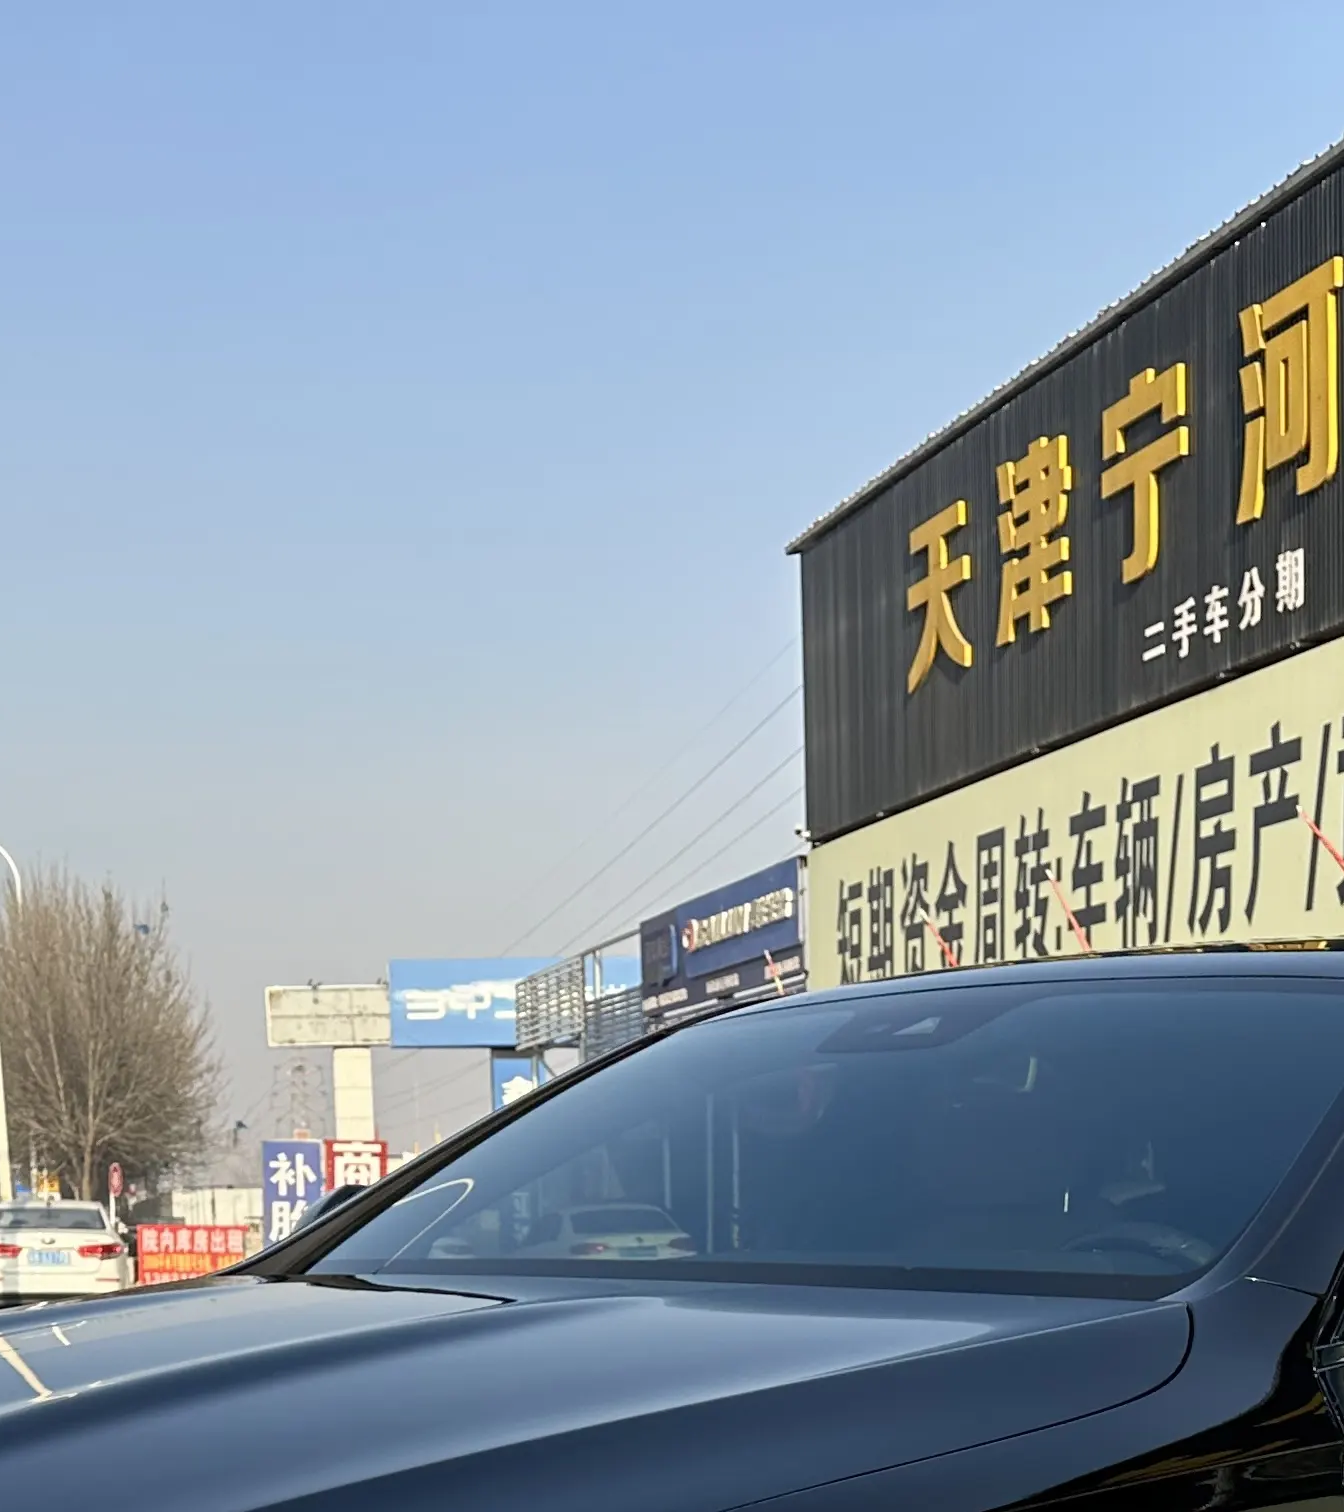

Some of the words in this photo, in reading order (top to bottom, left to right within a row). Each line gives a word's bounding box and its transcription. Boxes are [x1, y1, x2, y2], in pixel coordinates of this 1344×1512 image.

[1142, 548, 1305, 663] 二手车分期
